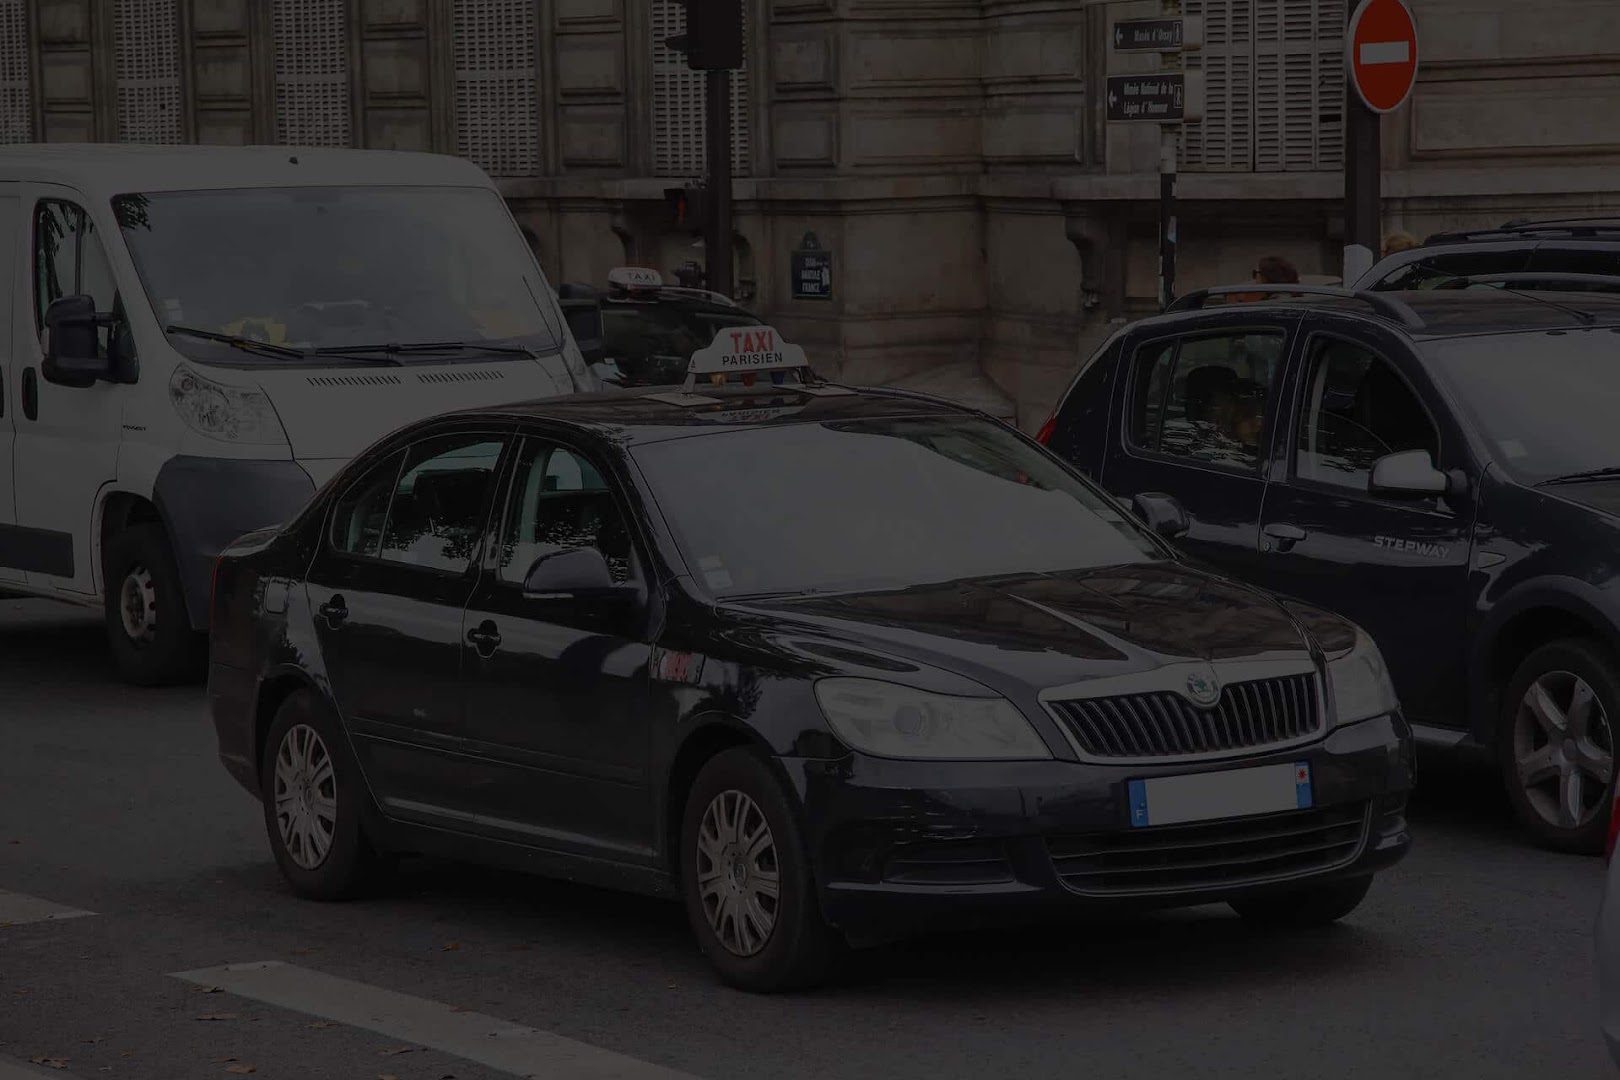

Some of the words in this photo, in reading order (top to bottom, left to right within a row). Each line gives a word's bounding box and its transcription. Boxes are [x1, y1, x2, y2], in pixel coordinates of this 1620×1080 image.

[625, 271, 655, 282] TAXI
[730, 330, 774, 353] TAXI
[722, 352, 783, 366] PARISIEN
[1372, 535, 1449, 559] STEPWAY
[1136, 810, 1144, 819] F
